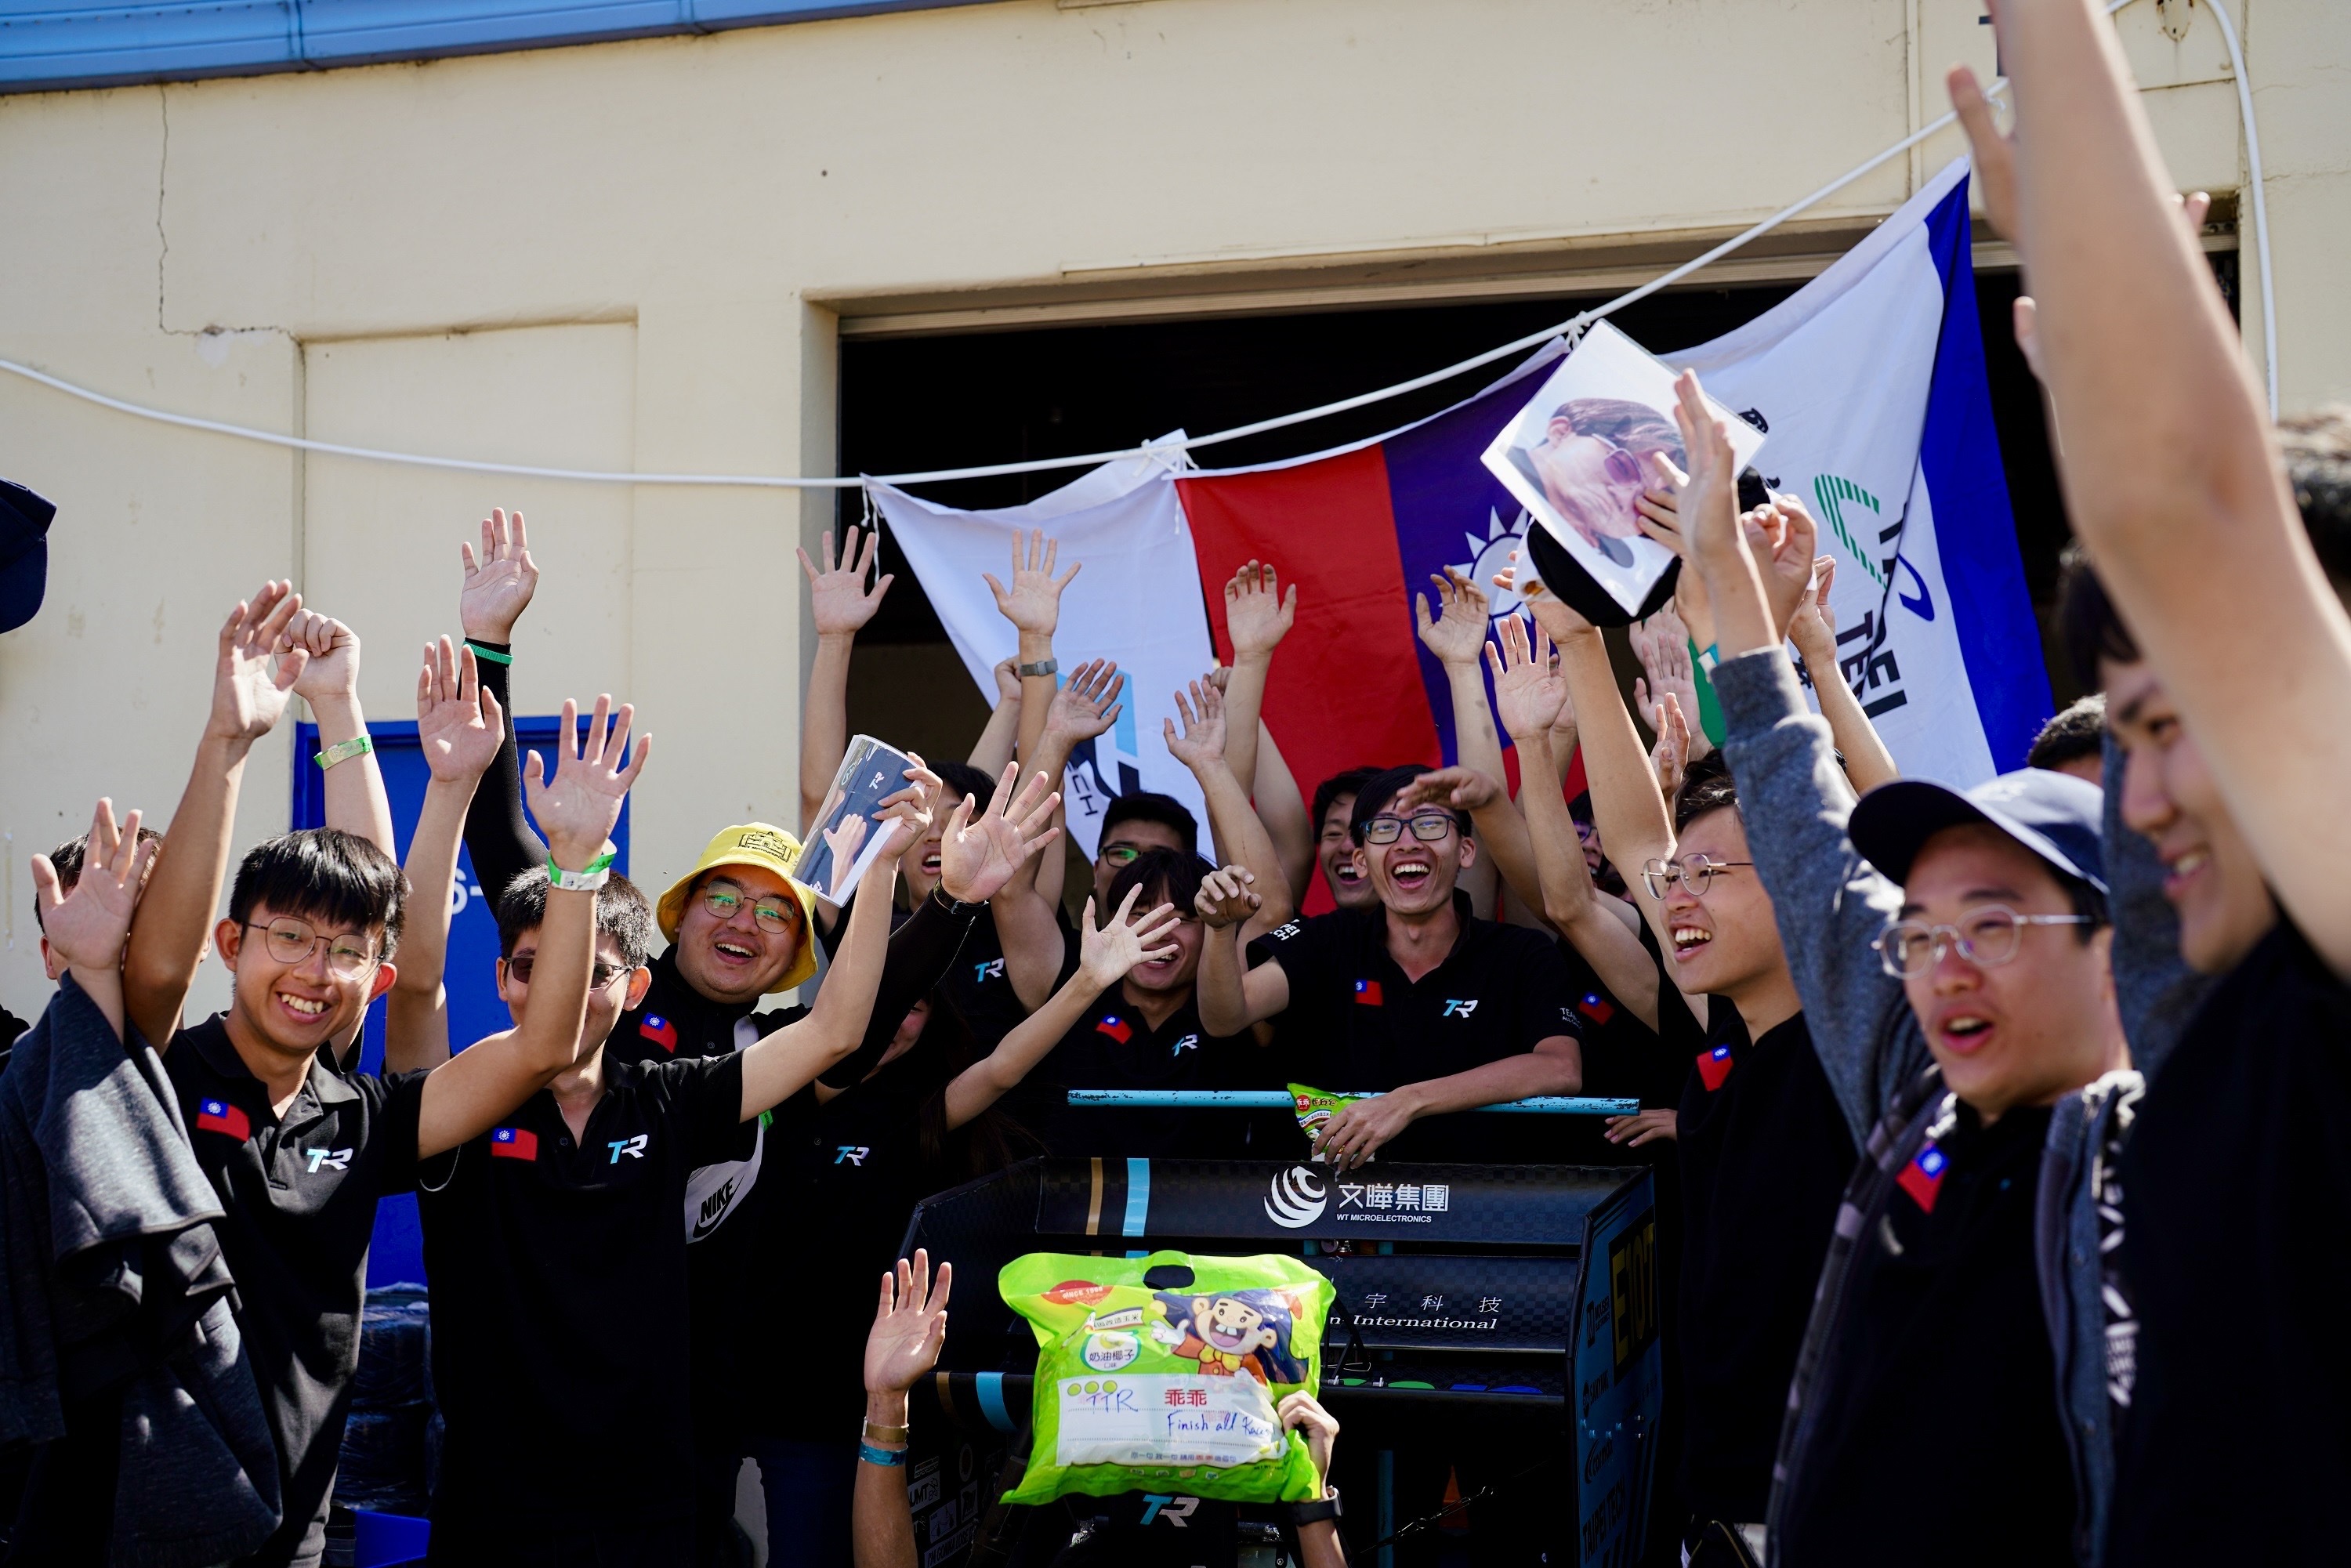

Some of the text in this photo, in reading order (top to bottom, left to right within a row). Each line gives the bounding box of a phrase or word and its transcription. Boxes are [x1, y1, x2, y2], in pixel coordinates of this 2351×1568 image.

[700, 1176, 734, 1224] NIKE
[1338, 1182, 1450, 1212] 文曄集團
[1350, 1214, 1433, 1223] MICROELECTRONICS
[1353, 1315, 1498, 1330] International
[1089, 1349, 1135, 1362] 奶油椰子
[1165, 1389, 1208, 1407] 乖乖
[1167, 1410, 1208, 1437] Finish
[1215, 1411, 1238, 1432] all
